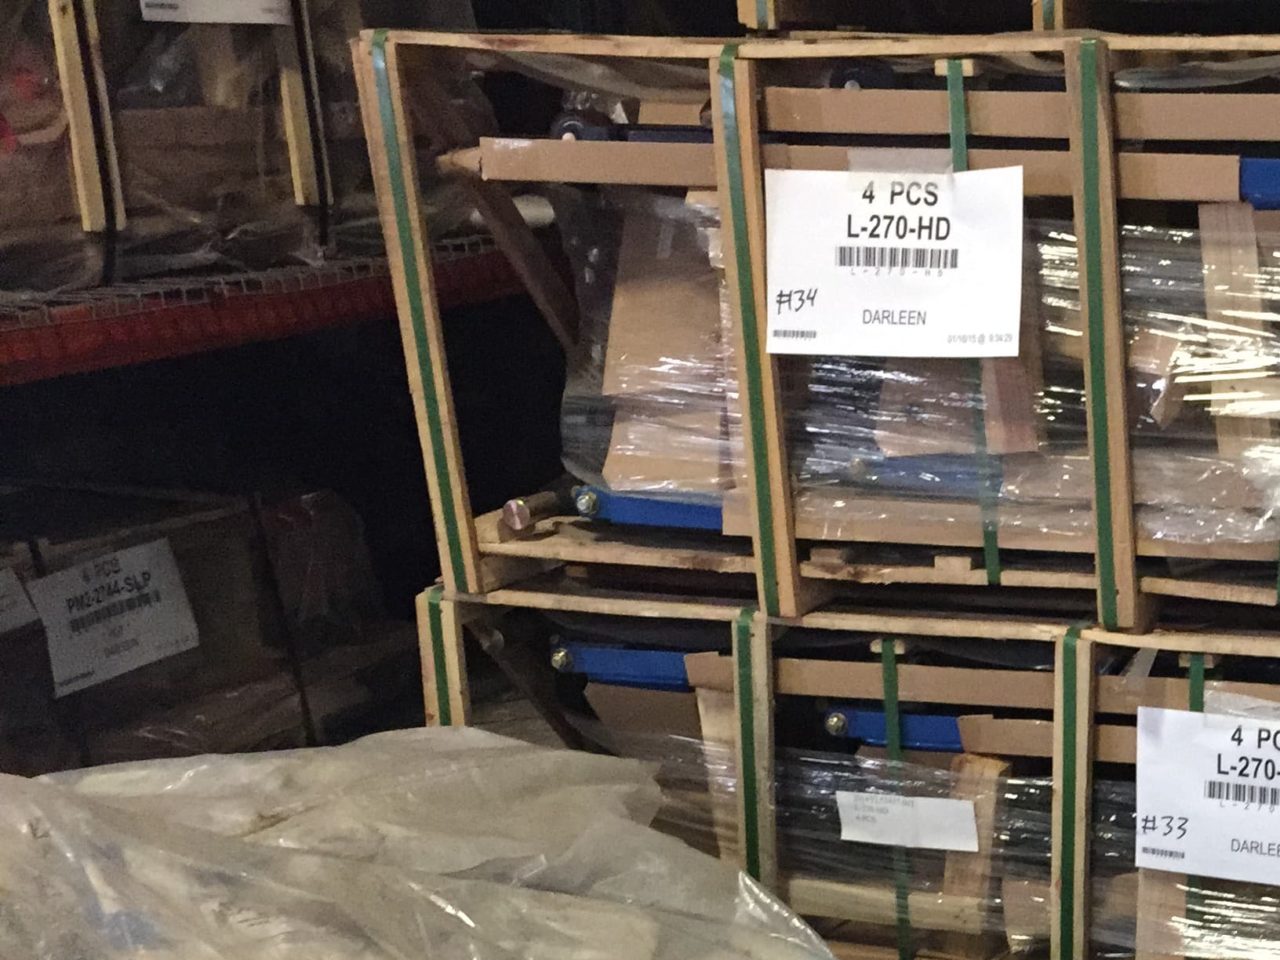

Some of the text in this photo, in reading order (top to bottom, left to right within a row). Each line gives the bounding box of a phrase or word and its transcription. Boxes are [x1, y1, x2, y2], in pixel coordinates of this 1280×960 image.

[861, 180, 939, 206] 4 PCS
[846, 213, 951, 240] L-270-HD
[861, 309, 927, 326] DARLEEN
[1230, 725, 1243, 746] 4
[1141, 815, 1189, 839] #33
